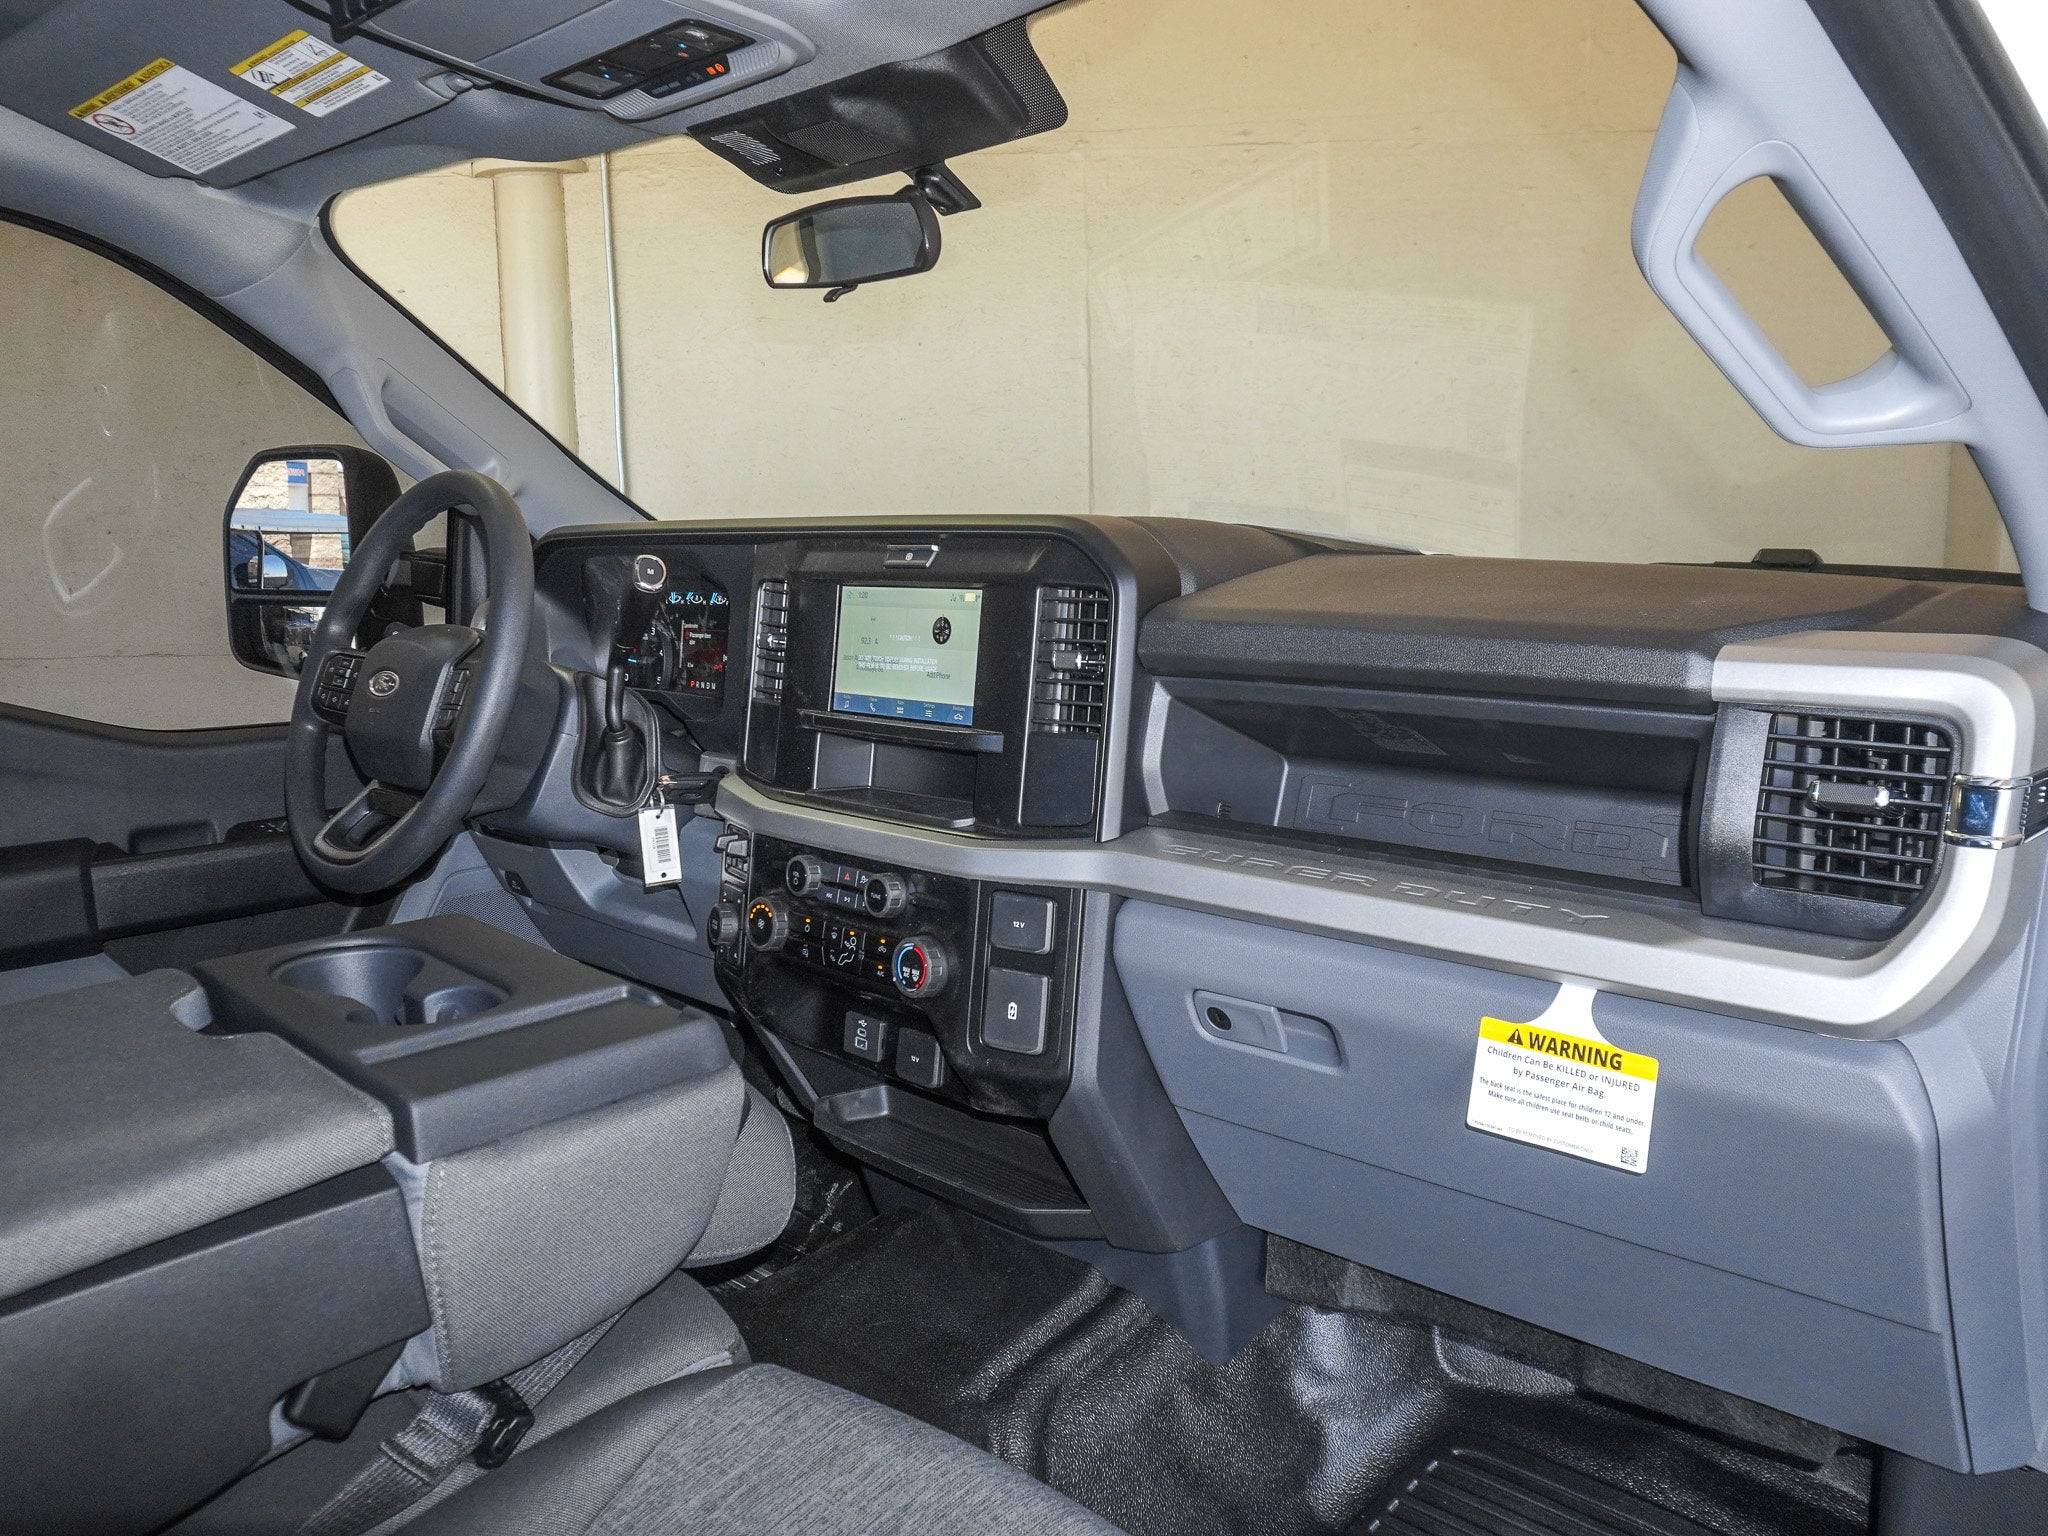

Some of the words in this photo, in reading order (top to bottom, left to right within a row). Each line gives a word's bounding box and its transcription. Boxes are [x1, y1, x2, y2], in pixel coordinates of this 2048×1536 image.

[1160, 844, 1377, 888] SUPER
[1391, 882, 1610, 925] DUTY
[1488, 1046, 1522, 1062] Children
[1524, 1056, 1540, 1066] Can
[1543, 1060, 1554, 1070] Be
[1556, 1064, 1586, 1078] KILLED
[1602, 1076, 1640, 1092] INJURED
[1529, 1032, 1623, 1070] WARNING
[1480, 1076, 1490, 1086] The
[1490, 1080, 1502, 1088] back
[1504, 1084, 1516, 1092] seat
[1534, 1092, 1550, 1102] safest
[1552, 1097, 1568, 1106] place
[1568, 1100, 1577, 1108] for
[1578, 1104, 1602, 1116] children
[1604, 1110, 1612, 1118] 12
[1612, 1113, 1625, 1121] and
[1513, 1067, 1523, 1078] by
[1526, 1070, 1569, 1088] Passenger
[1572, 1082, 1585, 1092] Air
[1588, 1086, 1606, 1100] Bag.
[1488, 1090, 1503, 1100] Make
[1504, 1096, 1516, 1104] sure
[1526, 1101, 1549, 1112] children
[1550, 1108, 1560, 1116] use
[1562, 1110, 1574, 1118] seat
[1576, 1114, 1590, 1123] belts
[1600, 1120, 1614, 1130] child
